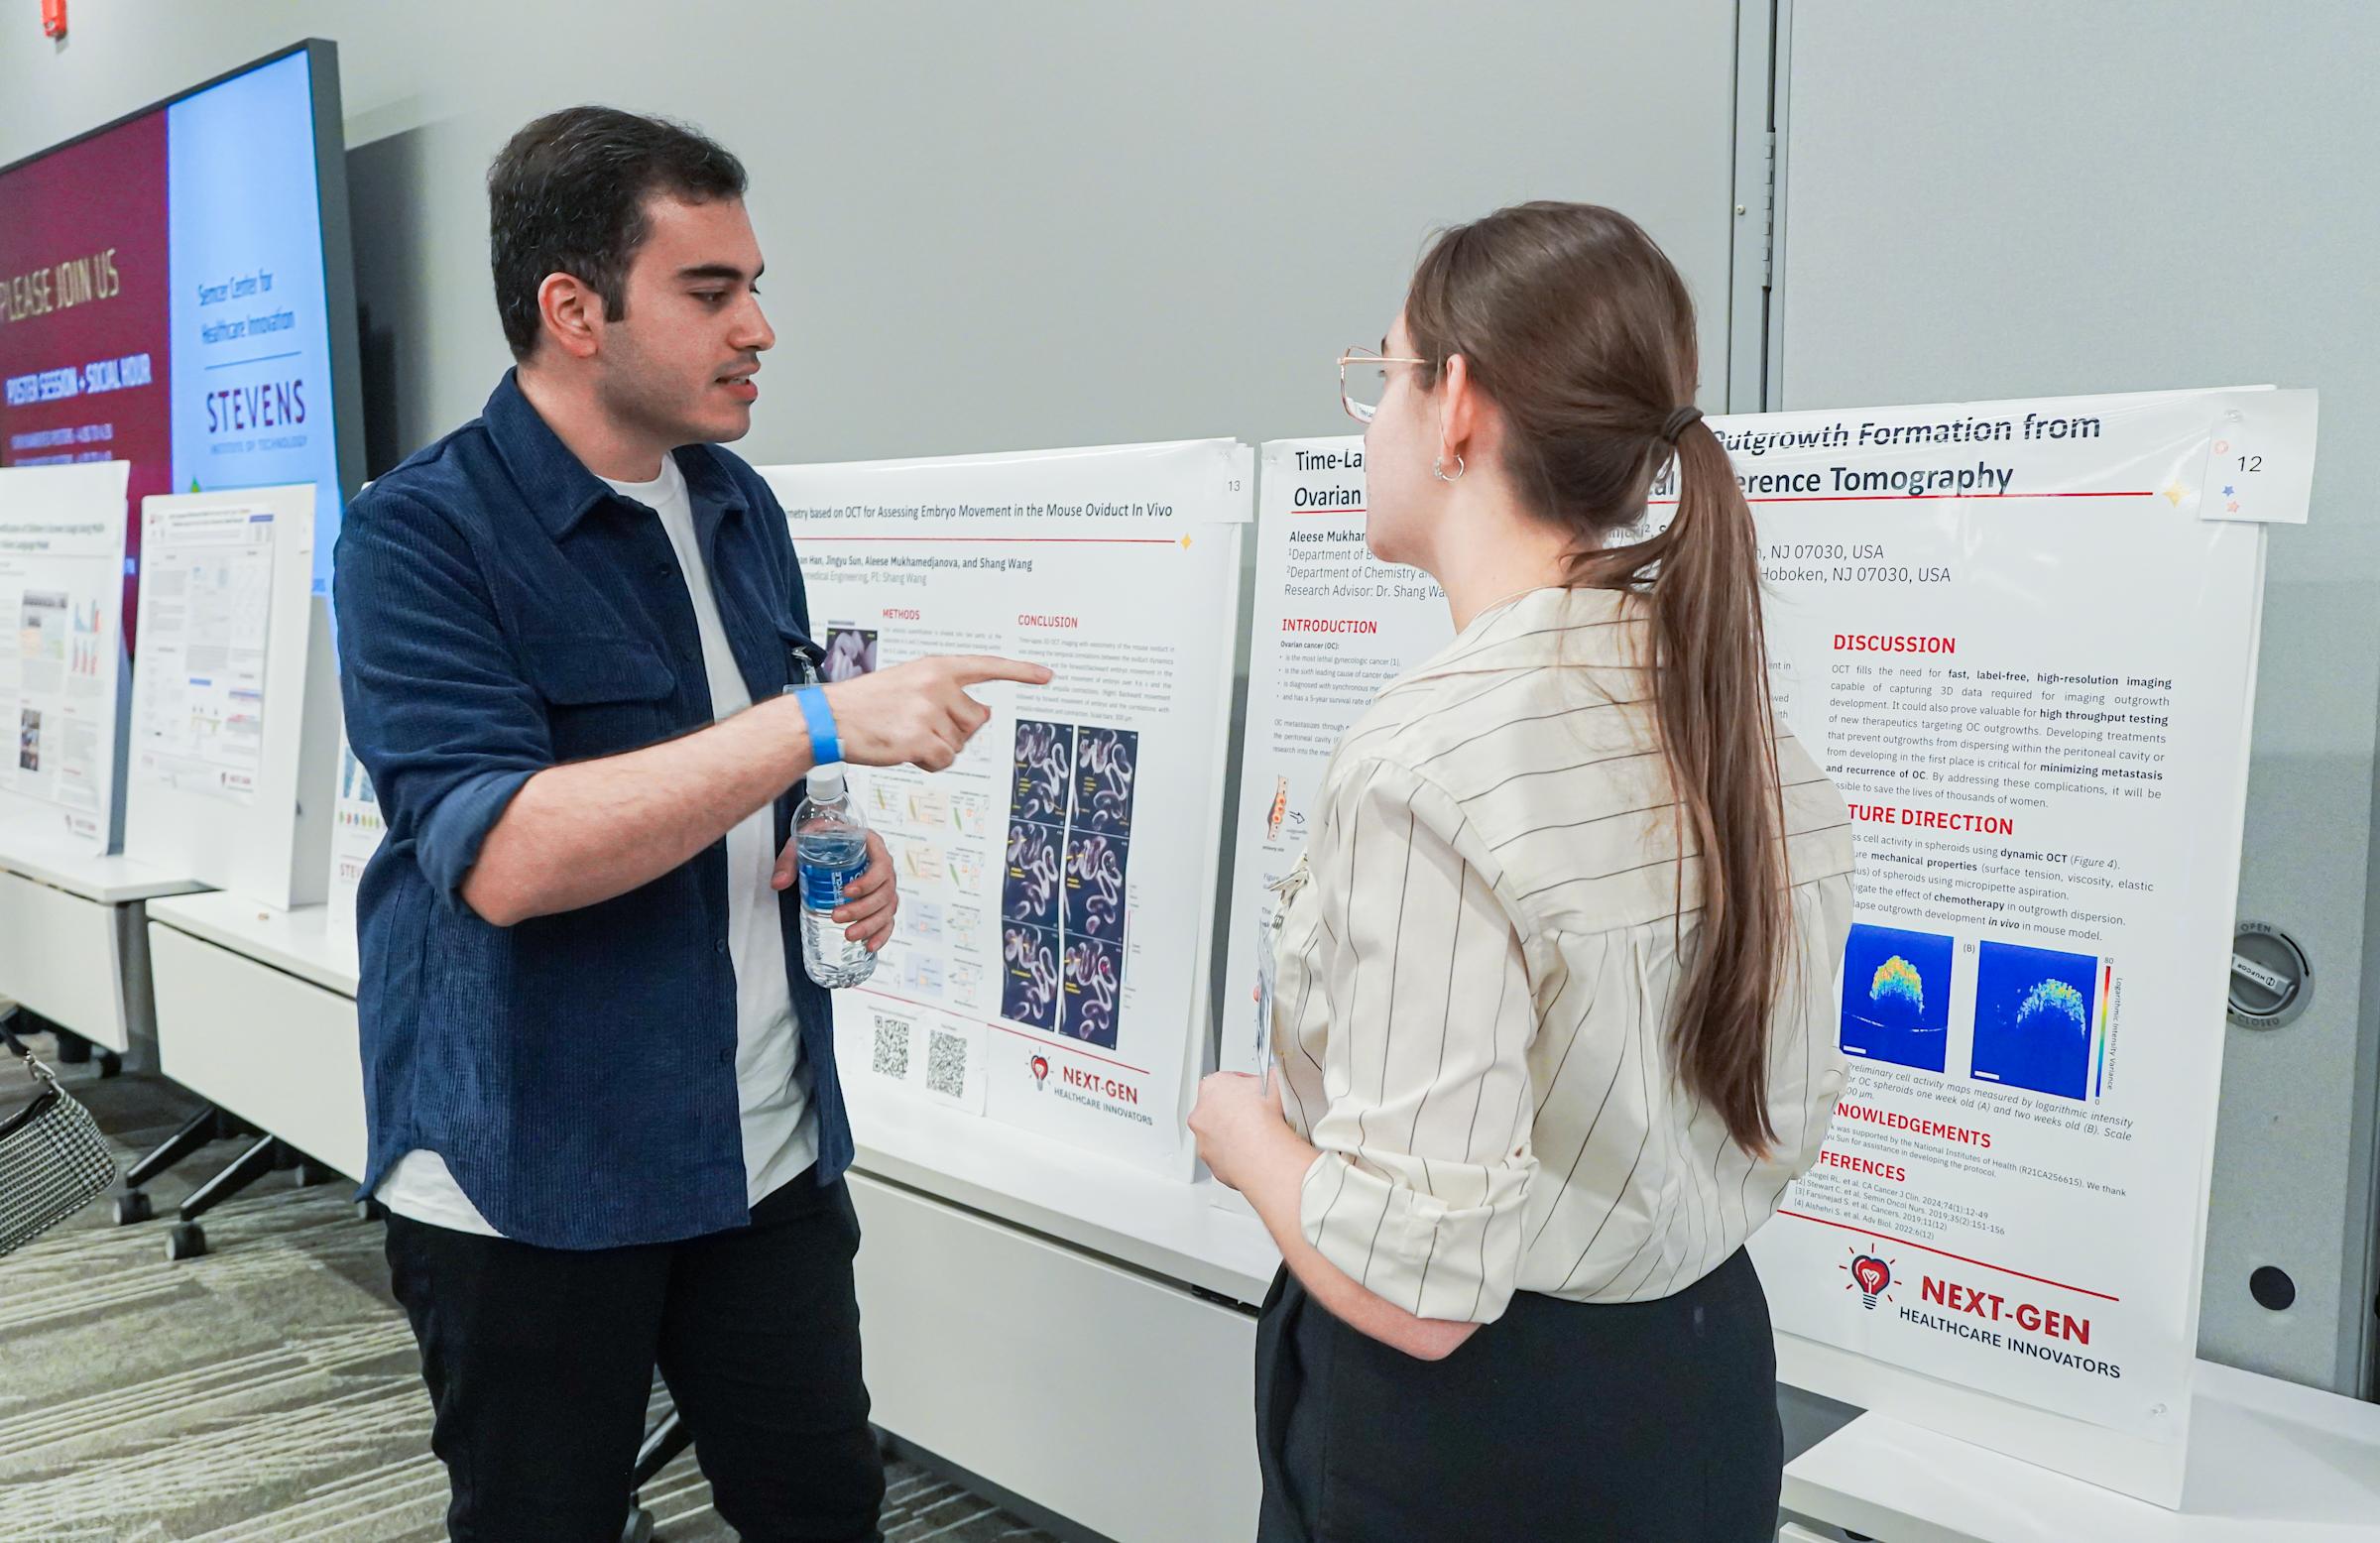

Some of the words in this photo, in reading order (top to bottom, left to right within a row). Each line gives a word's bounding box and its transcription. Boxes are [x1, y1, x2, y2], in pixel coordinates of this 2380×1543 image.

[56, 259, 92, 308] JOIN
[93, 249, 119, 298] US
[206, 379, 305, 433] STEVENS
[1858, 416, 2012, 445] Formation
[2023, 414, 2101, 440] from
[1295, 448, 1367, 472] Time-La
[2236, 455, 2263, 473] 12
[1228, 480, 1241, 492] 13
[1737, 471, 1821, 493] erence
[1830, 461, 2014, 497] Tomography
[1294, 485, 1362, 507] Ovarian
[845, 506, 862, 519] OCT
[863, 505, 876, 518] for
[877, 506, 918, 521] Assessing
[920, 504, 956, 521] Embryo
[958, 504, 1012, 518] Movement
[1013, 503, 1023, 517] in
[1026, 503, 1043, 517] the
[1046, 503, 1083, 517] Mouse
[1085, 502, 1129, 517] Oviduct
[1131, 503, 1143, 517] In
[1146, 502, 1173, 517] Vivo
[1289, 531, 1324, 542] Aleese
[864, 554, 889, 566] Aleese
[890, 555, 960, 569] Mukhamedjanova,
[962, 556, 978, 568] and
[979, 556, 1006, 572] Shang
[1008, 557, 1032, 573] Wang
[1353, 547, 1365, 560] of
[1771, 544, 1790, 559] NJ
[1794, 544, 1847, 561] 07030,
[1852, 544, 1884, 559] USA
[1351, 565, 1363, 579] of
[1364, 565, 1416, 581] Chemistry
[1760, 566, 1828, 585] Hoboken,
[1833, 566, 1852, 581] NJ
[1856, 566, 1912, 584] 07030,
[1918, 567, 1951, 582] USA
[1284, 583, 1330, 596] Research
[1331, 583, 1373, 597] Advisor:
[1375, 584, 1390, 597] Dr.
[1392, 584, 1426, 600] Shang
[1428, 585, 1445, 598] Wa
[883, 609, 920, 622] METHODS
[1017, 614, 1078, 628] CONCLUSION
[1282, 619, 1377, 634] INTRODUCTION
[1279, 640, 1303, 649] Ovarian
[1324, 642, 1340, 651] (OC):
[1834, 634, 1956, 653] DISCUSSION
[1832, 664, 1849, 673] OCT
[1856, 665, 1872, 674] fills
[1878, 666, 1893, 675] the
[1928, 667, 1942, 677] for
[1948, 668, 1969, 680] fast,
[1976, 669, 2029, 682] label-free,
[2037, 672, 2118, 685] high-resolution
[2126, 675, 2172, 690] imaging
[1892, 700, 1899, 710] It
[1902, 702, 1927, 711] could
[1929, 702, 1948, 713] also
[1950, 705, 1977, 714] prove
[1979, 705, 2021, 717] valuable
[2023, 707, 2037, 718] for
[2039, 708, 2063, 721] high
[2065, 710, 2126, 724] throughput
[2128, 714, 2168, 728] testing
[1828, 713, 1838, 723] of
[1862, 715, 1918, 728] therapeutics
[1921, 719, 1963, 733] targeting
[1965, 722, 1980, 732] OC
[1983, 724, 2041, 736] outgrowths.
[2046, 726, 2103, 742] Developing
[2107, 731, 2166, 744] treatments
[1847, 803, 1896, 824] TURE
[1901, 808, 2013, 835] DIRECTION
[1862, 834, 1878, 843] cell
[1880, 837, 1912, 849] activity
[1924, 841, 1969, 853] spheroids
[1972, 846, 1998, 859] using
[2000, 847, 2044, 861] dynamic
[2046, 852, 2069, 864] OCT
[2070, 855, 2104, 869] (Figure
[2106, 859, 2120, 870] 4).
[1870, 853, 1923, 865] mechanical
[1927, 859, 1977, 872] properties
[1981, 863, 2021, 877] (surface
[2024, 869, 2064, 882] tension,
[2068, 873, 2113, 889] viscosity,
[2118, 879, 2154, 891] elastic
[2240, 922, 2272, 933] OPEN
[1963, 943, 1976, 955] (B)
[2113, 977, 2123, 1021] Logarithmic
[2237, 1015, 2280, 1027] CLOSED
[2109, 1023, 2119, 1057] Intensity
[1063, 1066, 1138, 1105] NEXT-GEN
[2107, 1058, 2116, 1090] Variance
[1054, 1088, 1101, 1111] HEALTHCARE
[1103, 1102, 1153, 1127] INNOVATORS
[1895, 1071, 1911, 1082] cell
[1913, 1077, 1945, 1091] activity
[1946, 1083, 1971, 1095] maps
[1973, 1089, 2019, 1104] measured
[2021, 1096, 2033, 1109] by
[2035, 1099, 2087, 1119] logarithmic
[2090, 1111, 2134, 1129] intensity
[1838, 1101, 1991, 1148] NOWLEDGEMENTS
[1821, 1151, 1906, 1182] FERENCES
[1851, 1128, 1888, 1141] supported
[1889, 1135, 1899, 1145] by
[1900, 1137, 1912, 1147] the
[1913, 1140, 1944, 1154] National
[1946, 1147, 1980, 1163] Institutes
[1991, 1158, 2017, 1172] Health
[2086, 1181, 2100, 1191] We
[2102, 1184, 2126, 1196] thank
[1922, 1276, 2090, 1345] NEXT-GEN
[1900, 1307, 2000, 1348] HEALTHCARE
[2008, 1338, 2120, 1378] INNOVATORS
